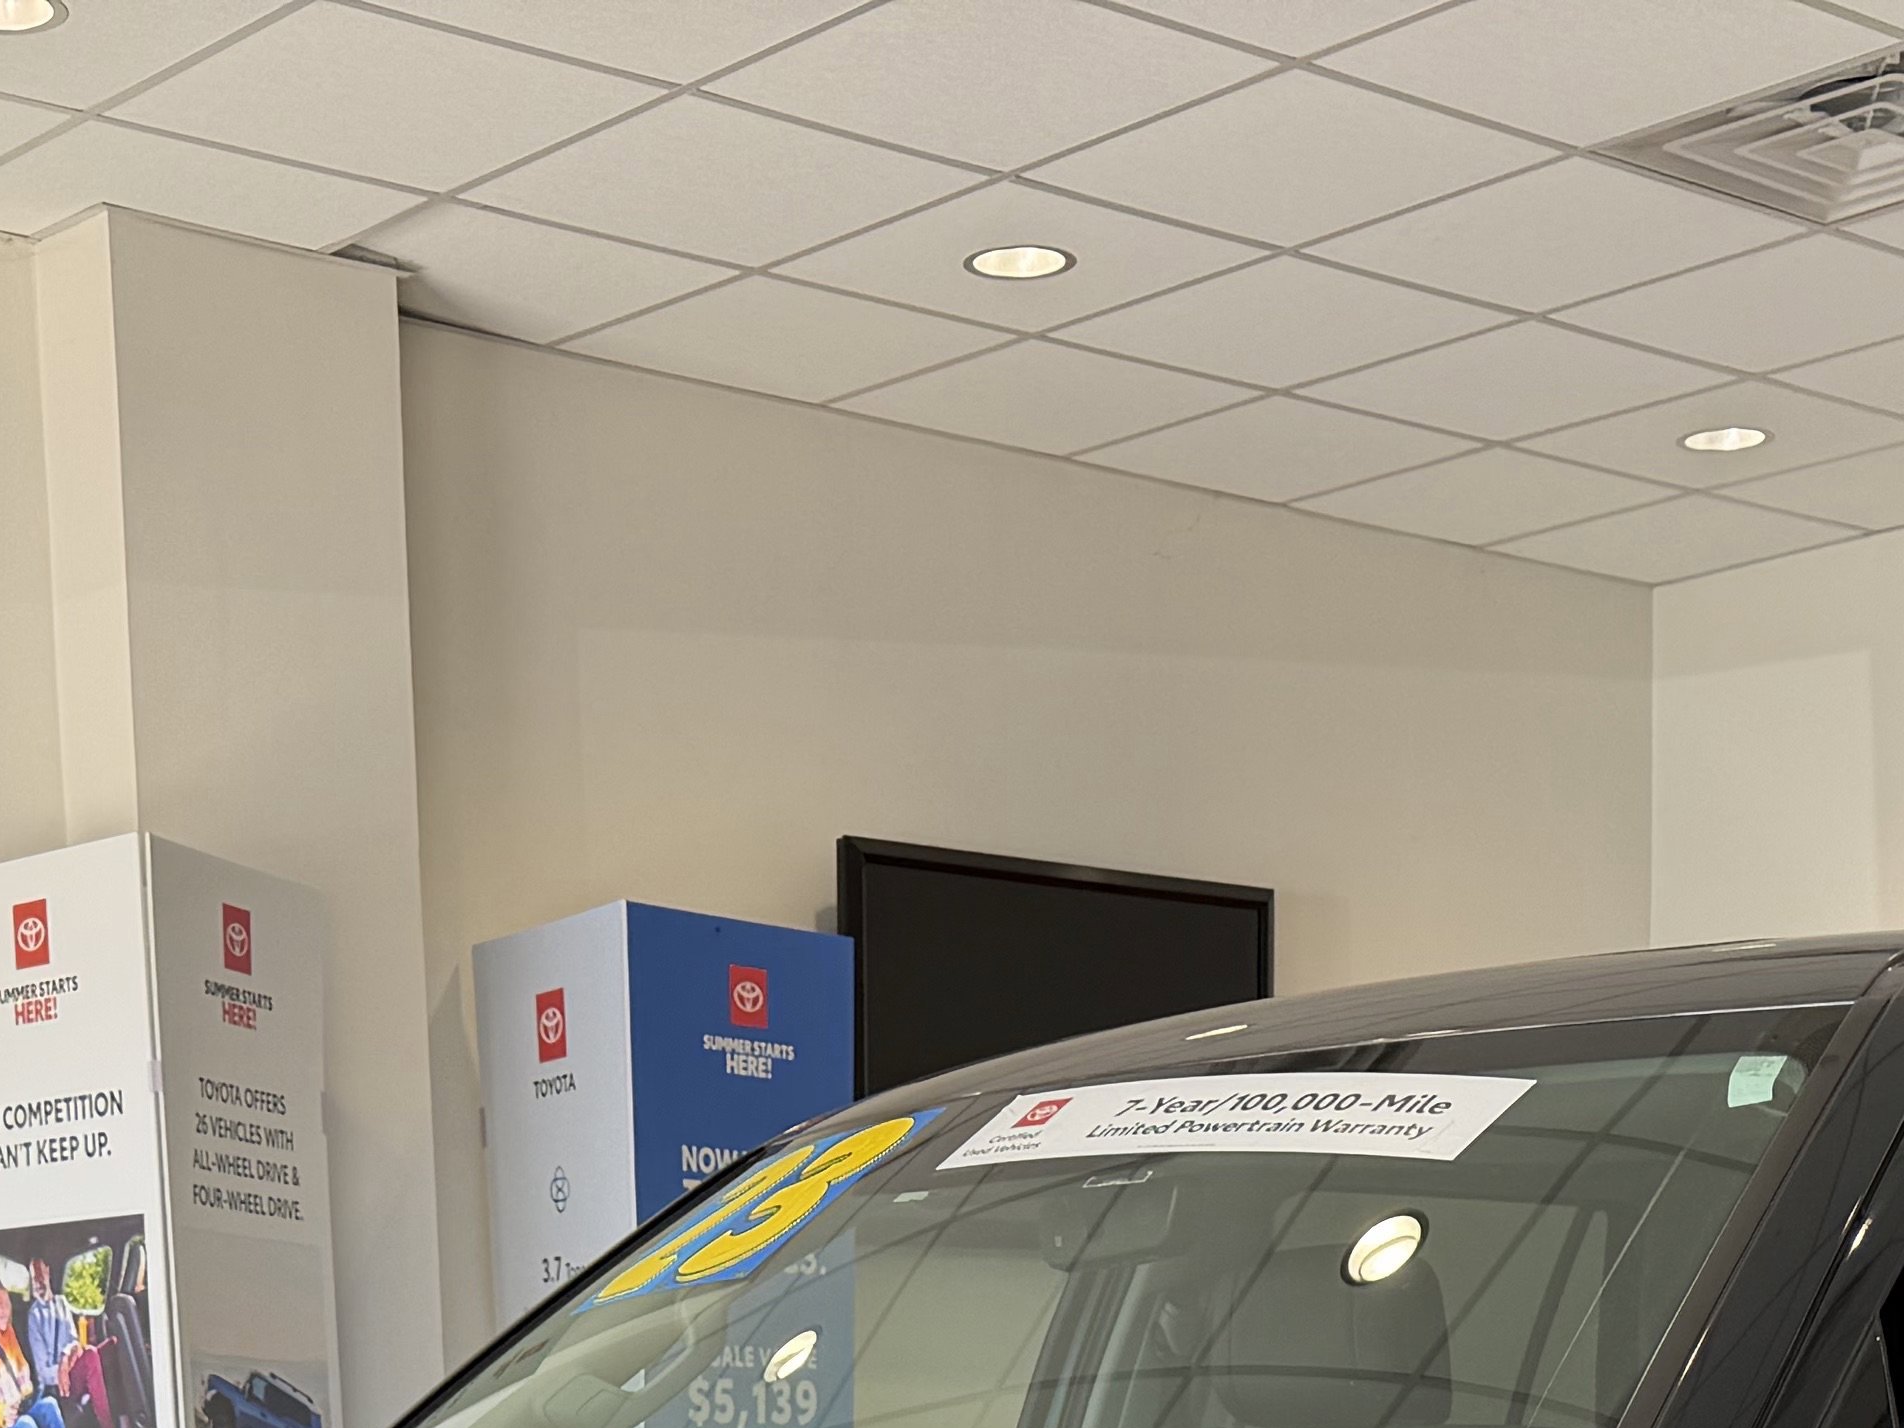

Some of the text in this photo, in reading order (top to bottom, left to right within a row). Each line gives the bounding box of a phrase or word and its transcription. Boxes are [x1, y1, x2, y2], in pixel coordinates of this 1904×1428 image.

[39, 976, 78, 998] STARTS
[204, 979, 273, 1011] SUMMER STARTS
[14, 997, 58, 1025] HERE!
[222, 1002, 257, 1030] HERE!
[703, 1034, 795, 1061] SUMMER STARTS
[725, 1053, 772, 1079] HERE!
[199, 1077, 287, 1115] TOYOTA OFFERS
[533, 1073, 577, 1099] TOYOTA
[3, 1090, 123, 1130] COMPETITION
[1114, 1092, 1453, 1117] 7-Year/100,000-Mile
[195, 1112, 294, 1151] 26 VEHICLES WITH
[1086, 1118, 1434, 1140] Limited Powertrain Warranty
[37, 1136, 79, 1165] KEEP
[84, 1131, 112, 1158] UP.
[193, 1148, 300, 1187] ALL-WHEEL DRIVE &
[193, 1184, 304, 1221] FOUR-WHEEL DRIVE.
[594, 1116, 915, 1305] 23
[542, 1256, 561, 1283] 3.7
[688, 1375, 817, 1428] $5,139
